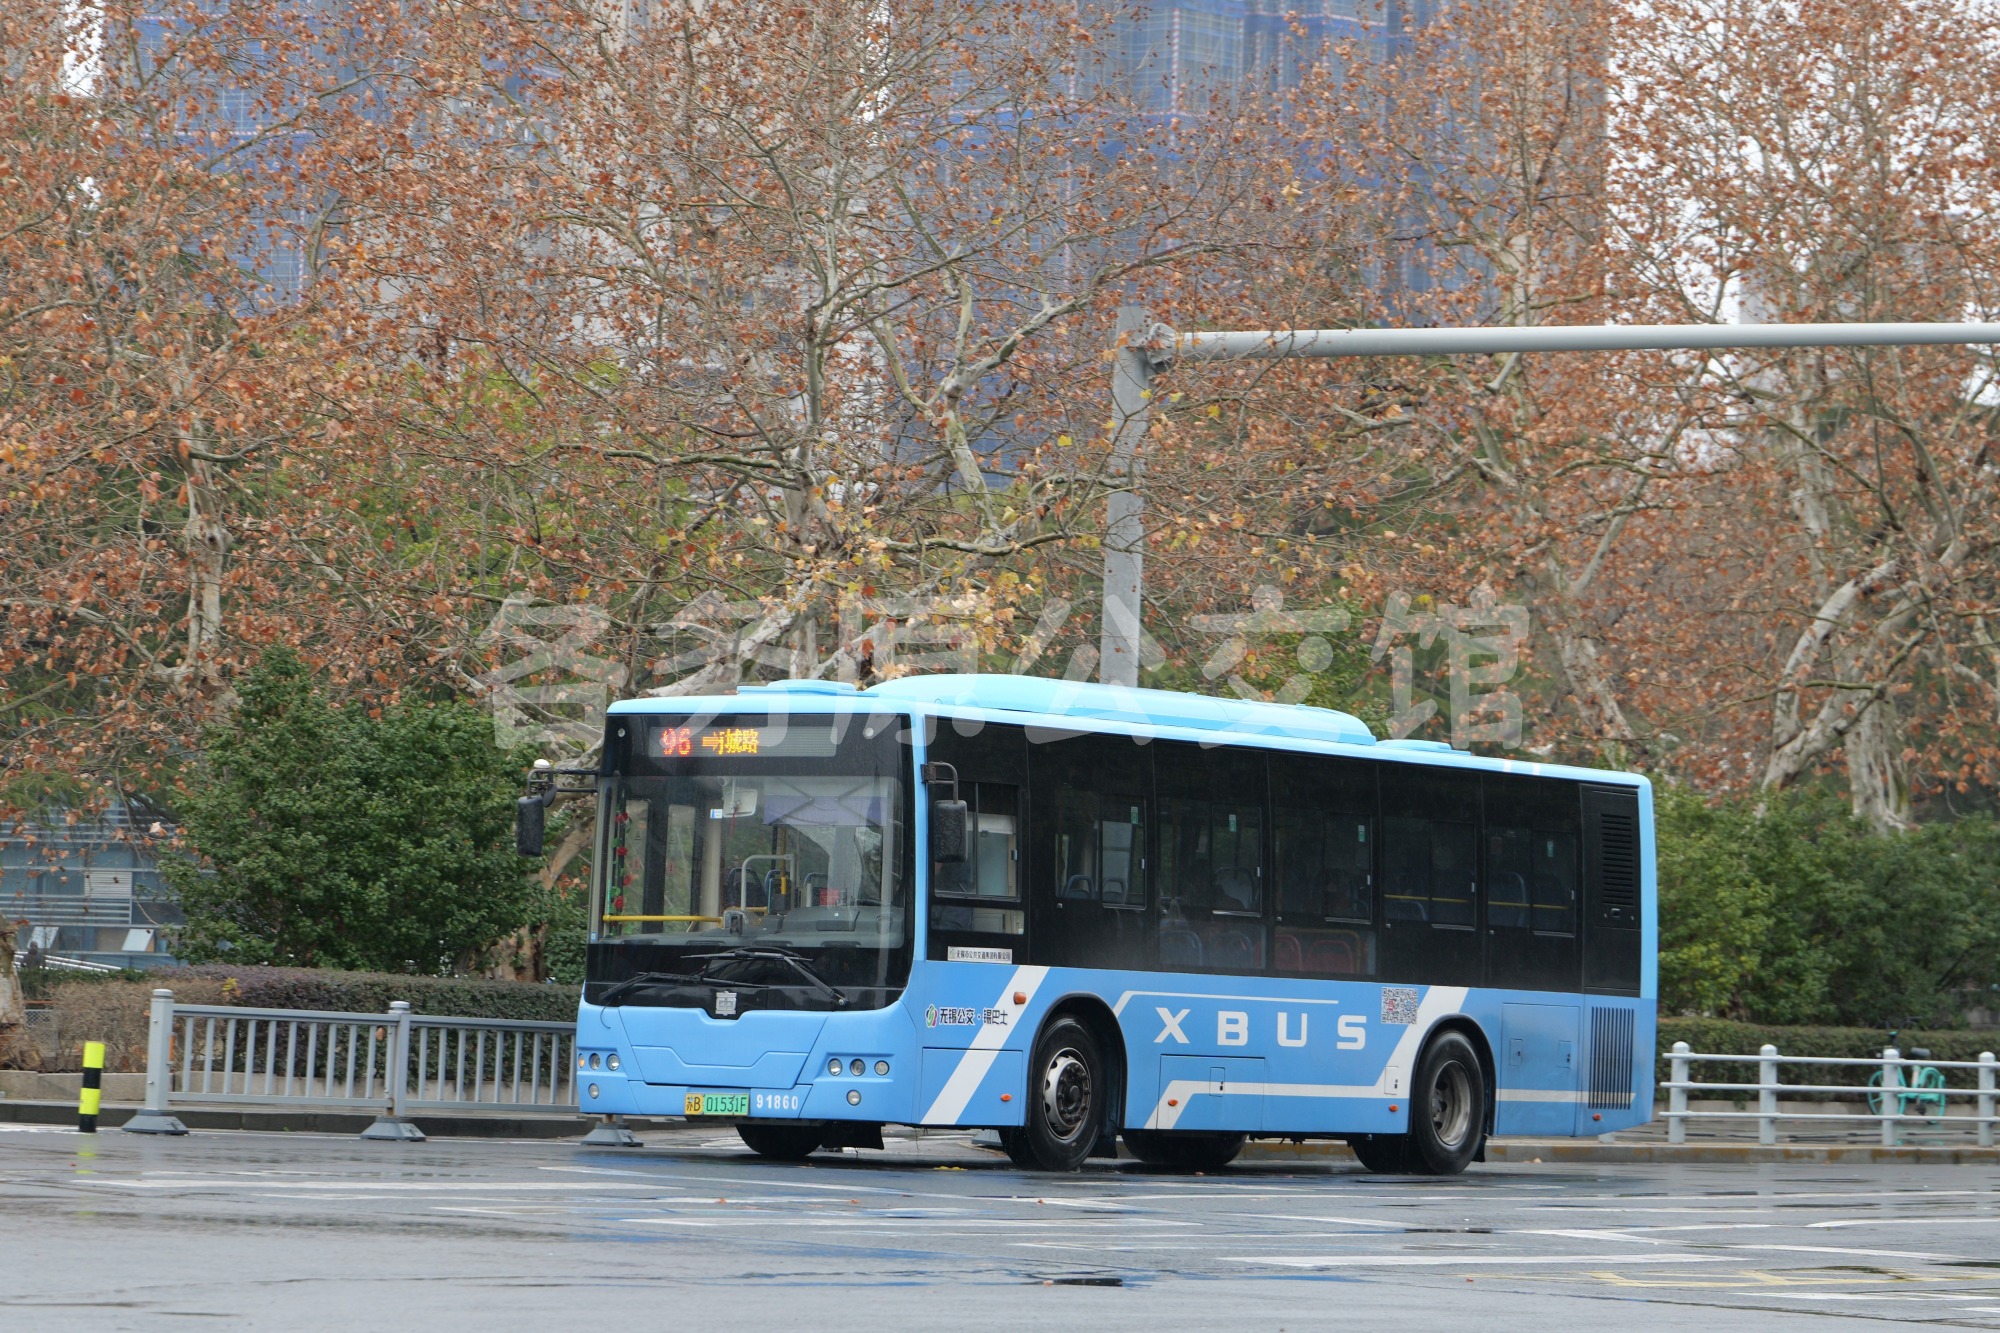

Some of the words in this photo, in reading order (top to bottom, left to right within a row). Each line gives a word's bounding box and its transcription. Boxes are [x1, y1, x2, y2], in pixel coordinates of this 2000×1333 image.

[662, 728, 692, 755] 96
[1153, 1007, 1367, 1050] XBUS
[756, 1094, 798, 1110] 91860
